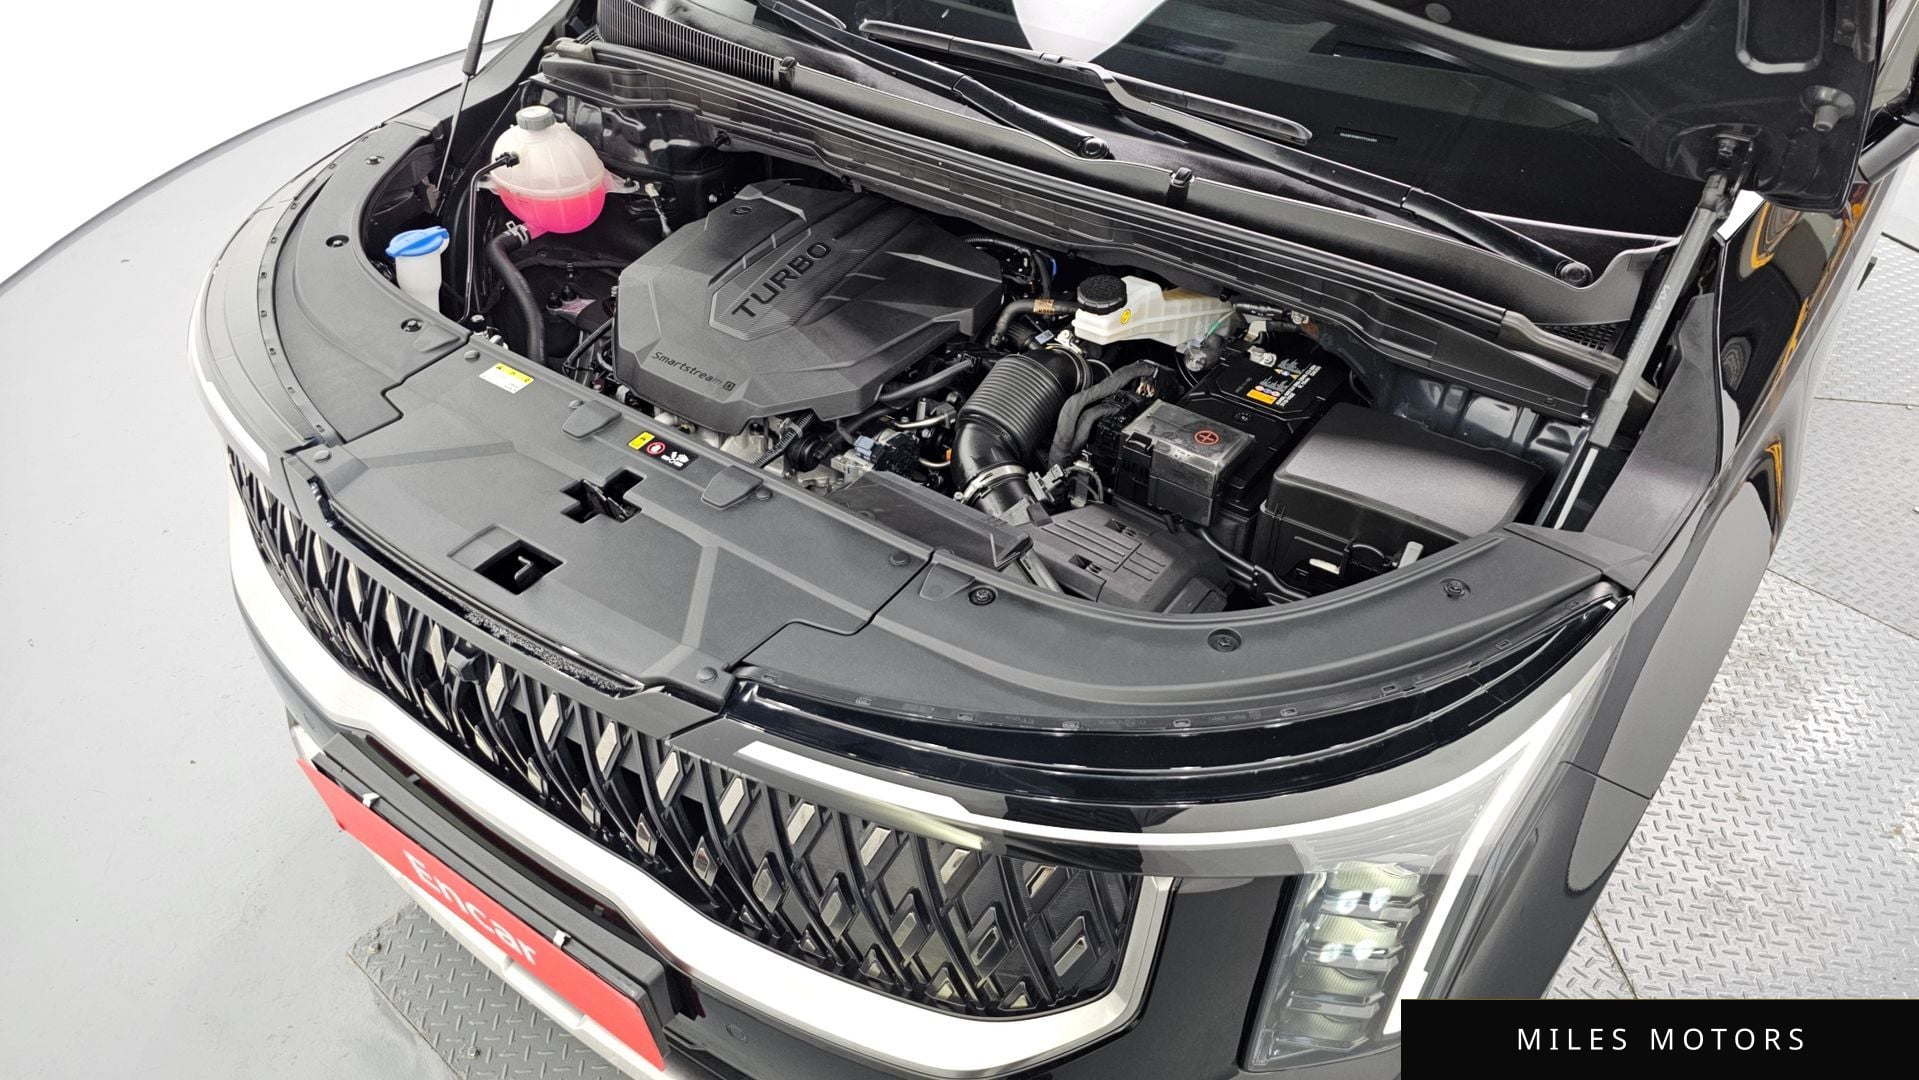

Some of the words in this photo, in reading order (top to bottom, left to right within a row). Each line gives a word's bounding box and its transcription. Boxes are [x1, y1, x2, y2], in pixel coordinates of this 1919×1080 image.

[731, 242, 831, 317] TURBO
[651, 351, 723, 386] Smartstream
[402, 849, 536, 966] Encar
